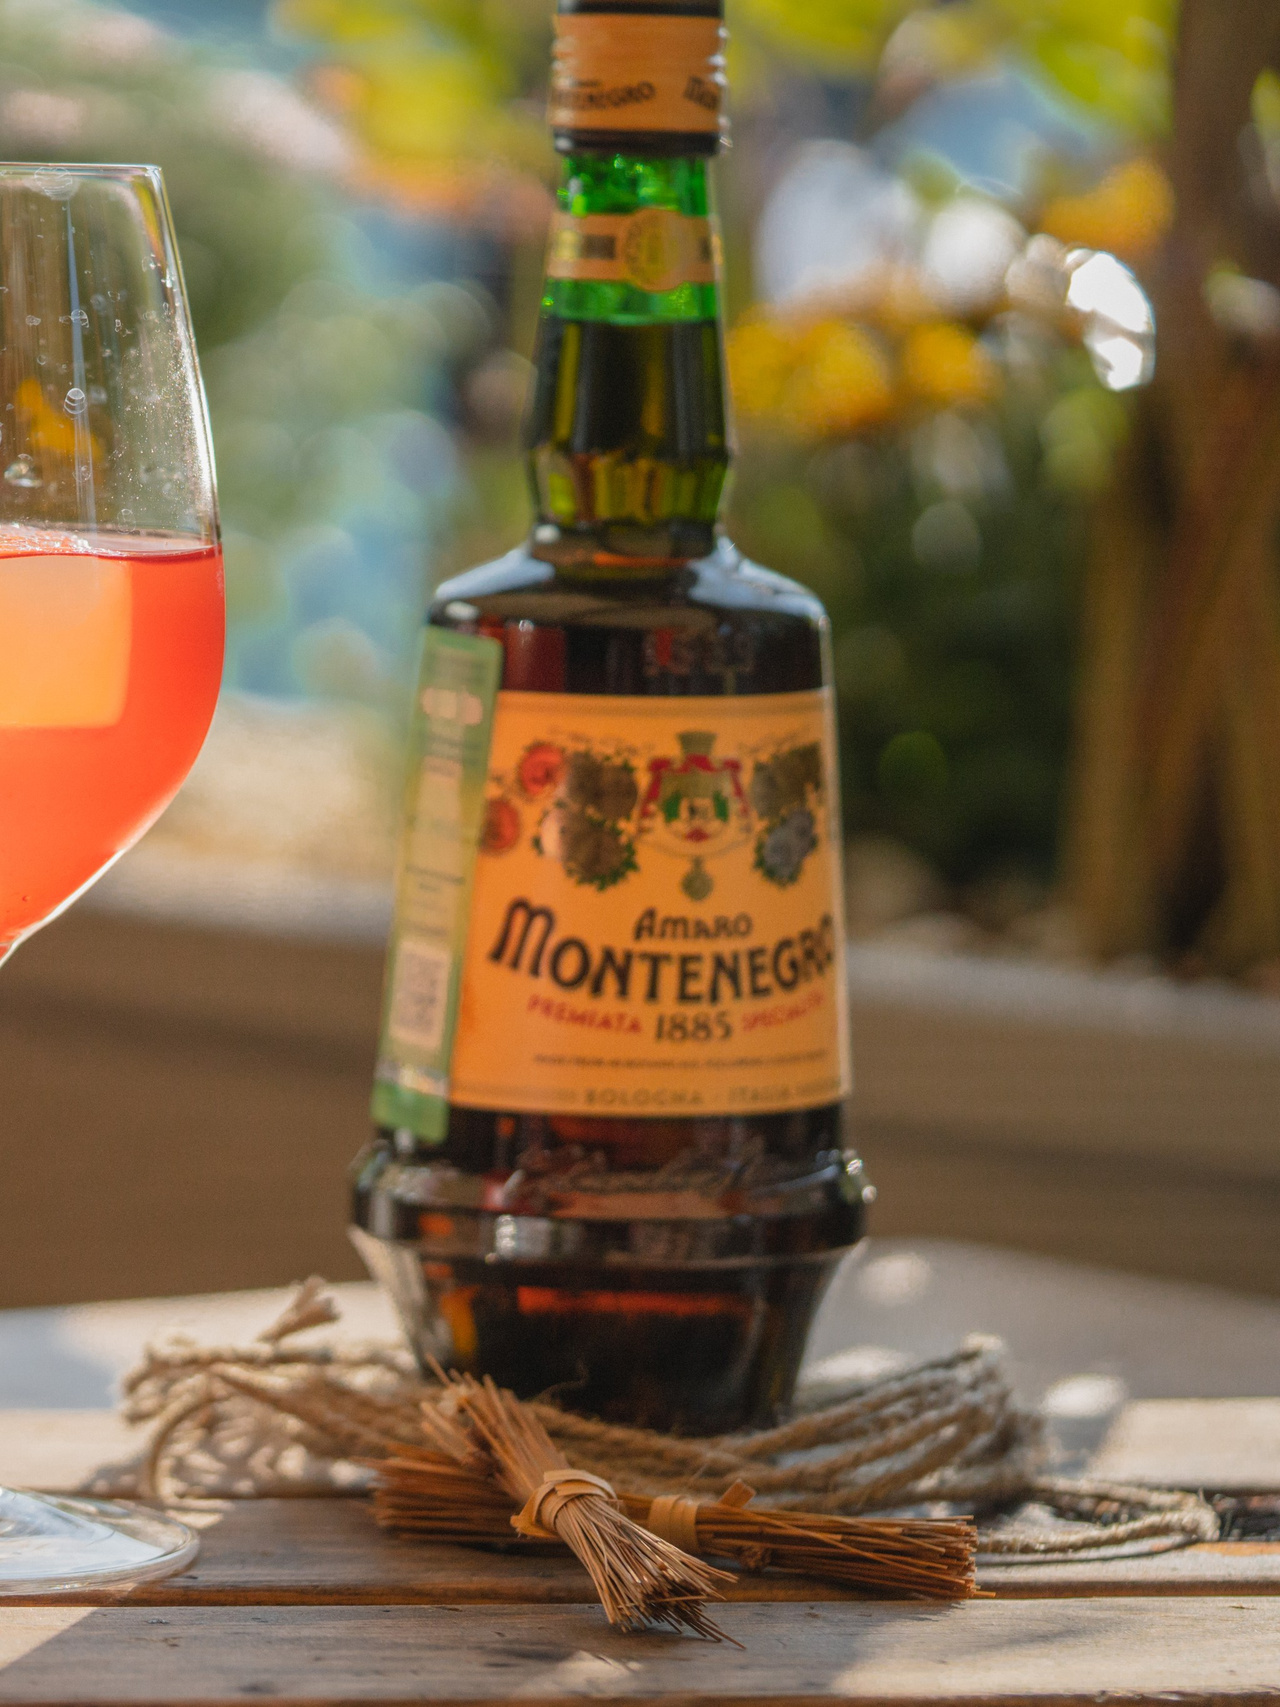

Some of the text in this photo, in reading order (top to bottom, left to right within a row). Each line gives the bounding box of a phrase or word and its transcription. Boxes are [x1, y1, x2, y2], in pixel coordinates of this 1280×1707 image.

[634, 908, 753, 941] AMARO
[526, 995, 643, 1034] PREMIATA
[655, 1012, 733, 1043] 1885
